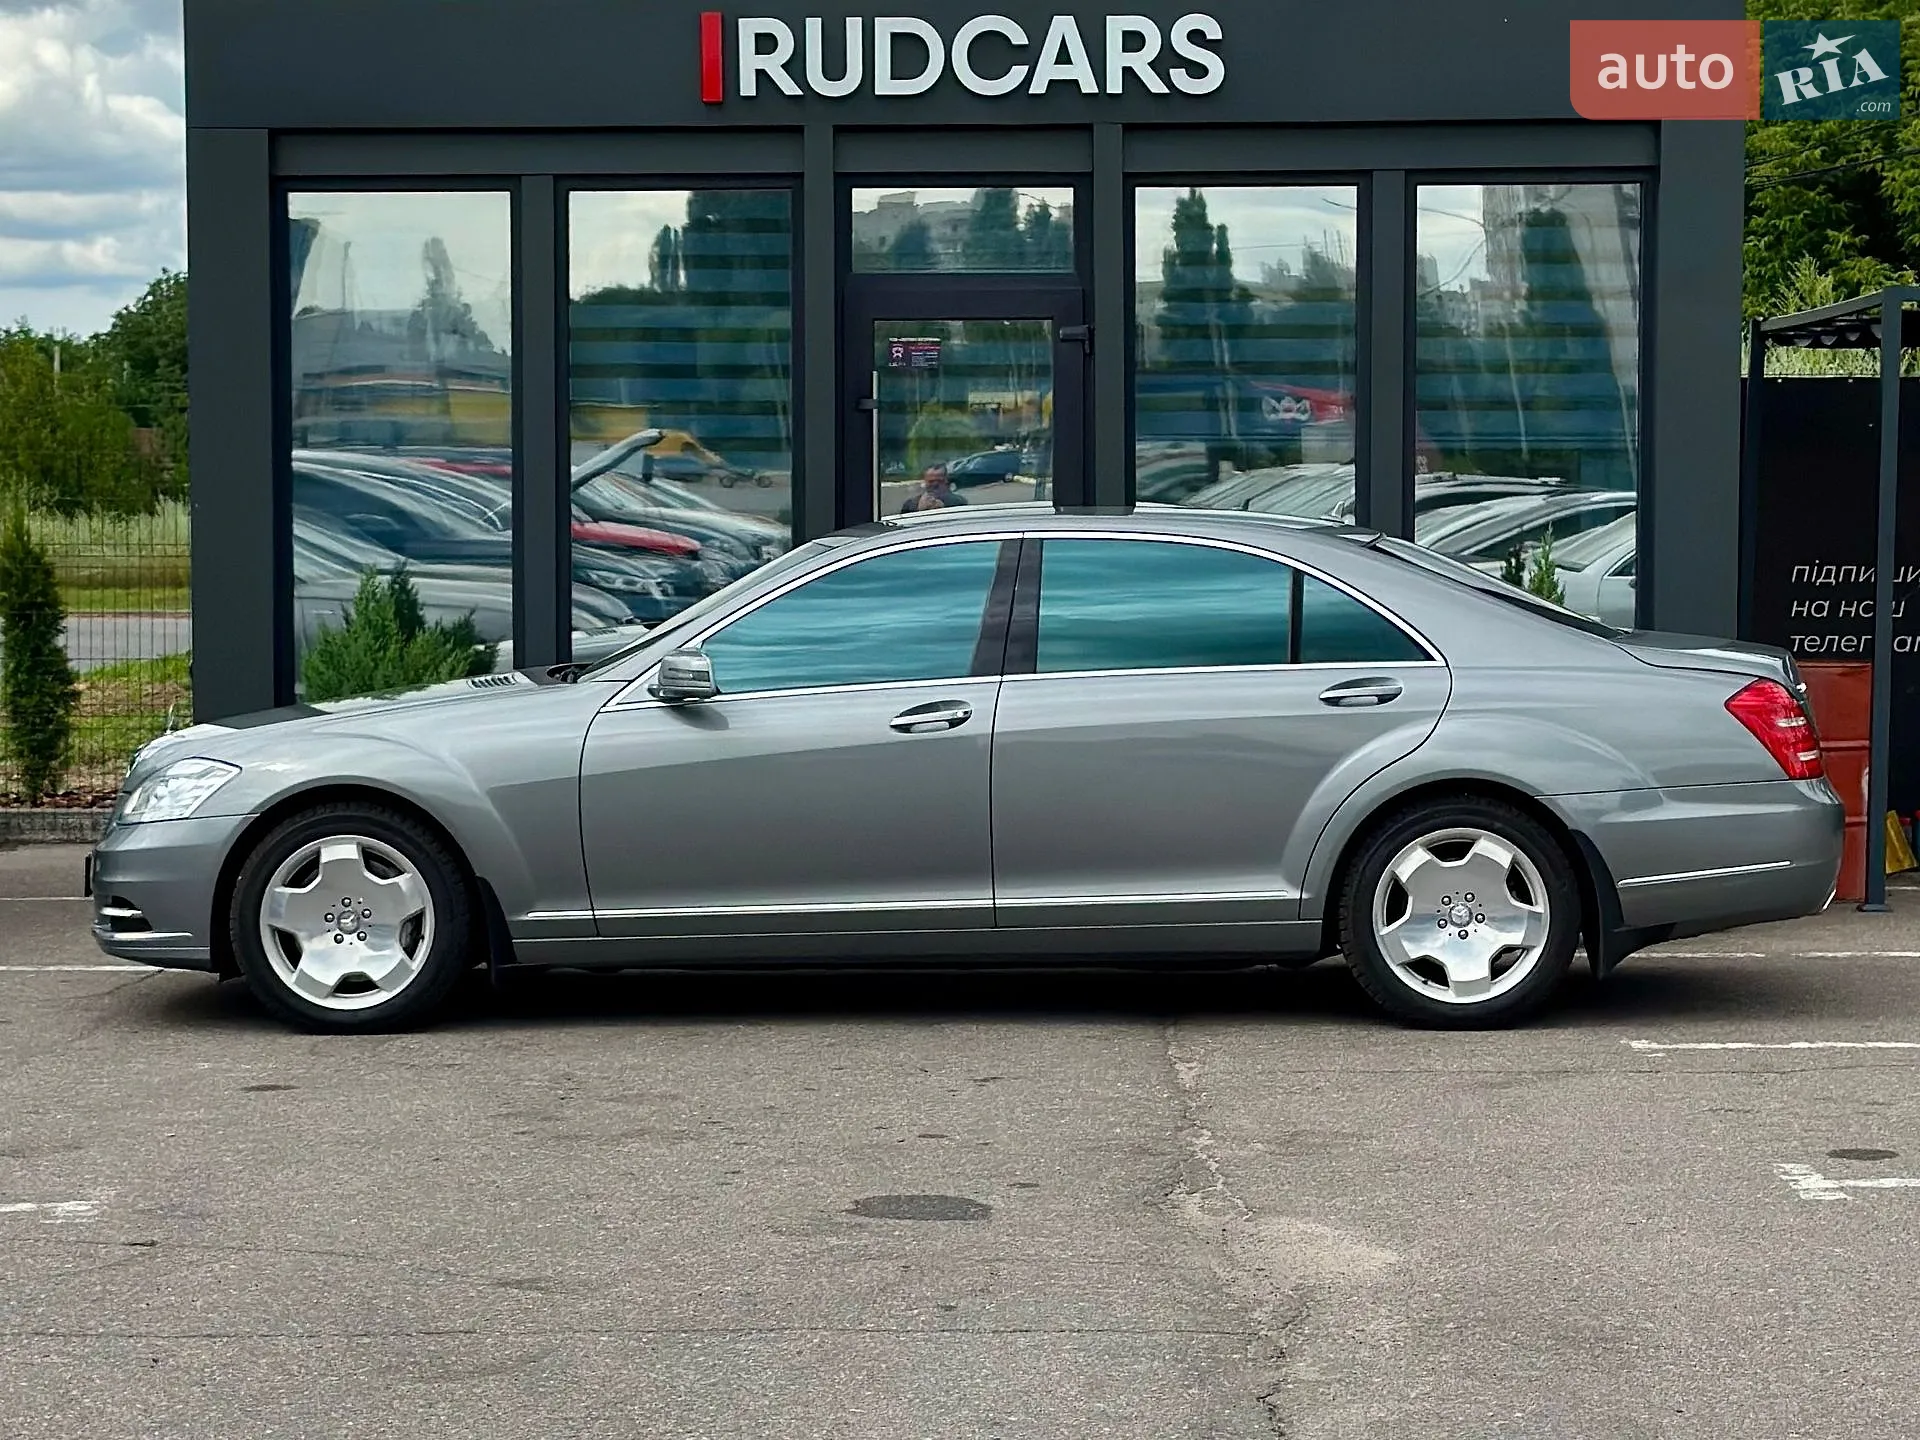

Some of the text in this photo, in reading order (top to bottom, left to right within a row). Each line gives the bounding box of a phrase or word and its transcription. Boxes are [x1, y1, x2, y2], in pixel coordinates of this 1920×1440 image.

[737, 14, 1226, 97] RUDCARS
[1791, 600, 1830, 618] на
[1790, 635, 1920, 653] телега
